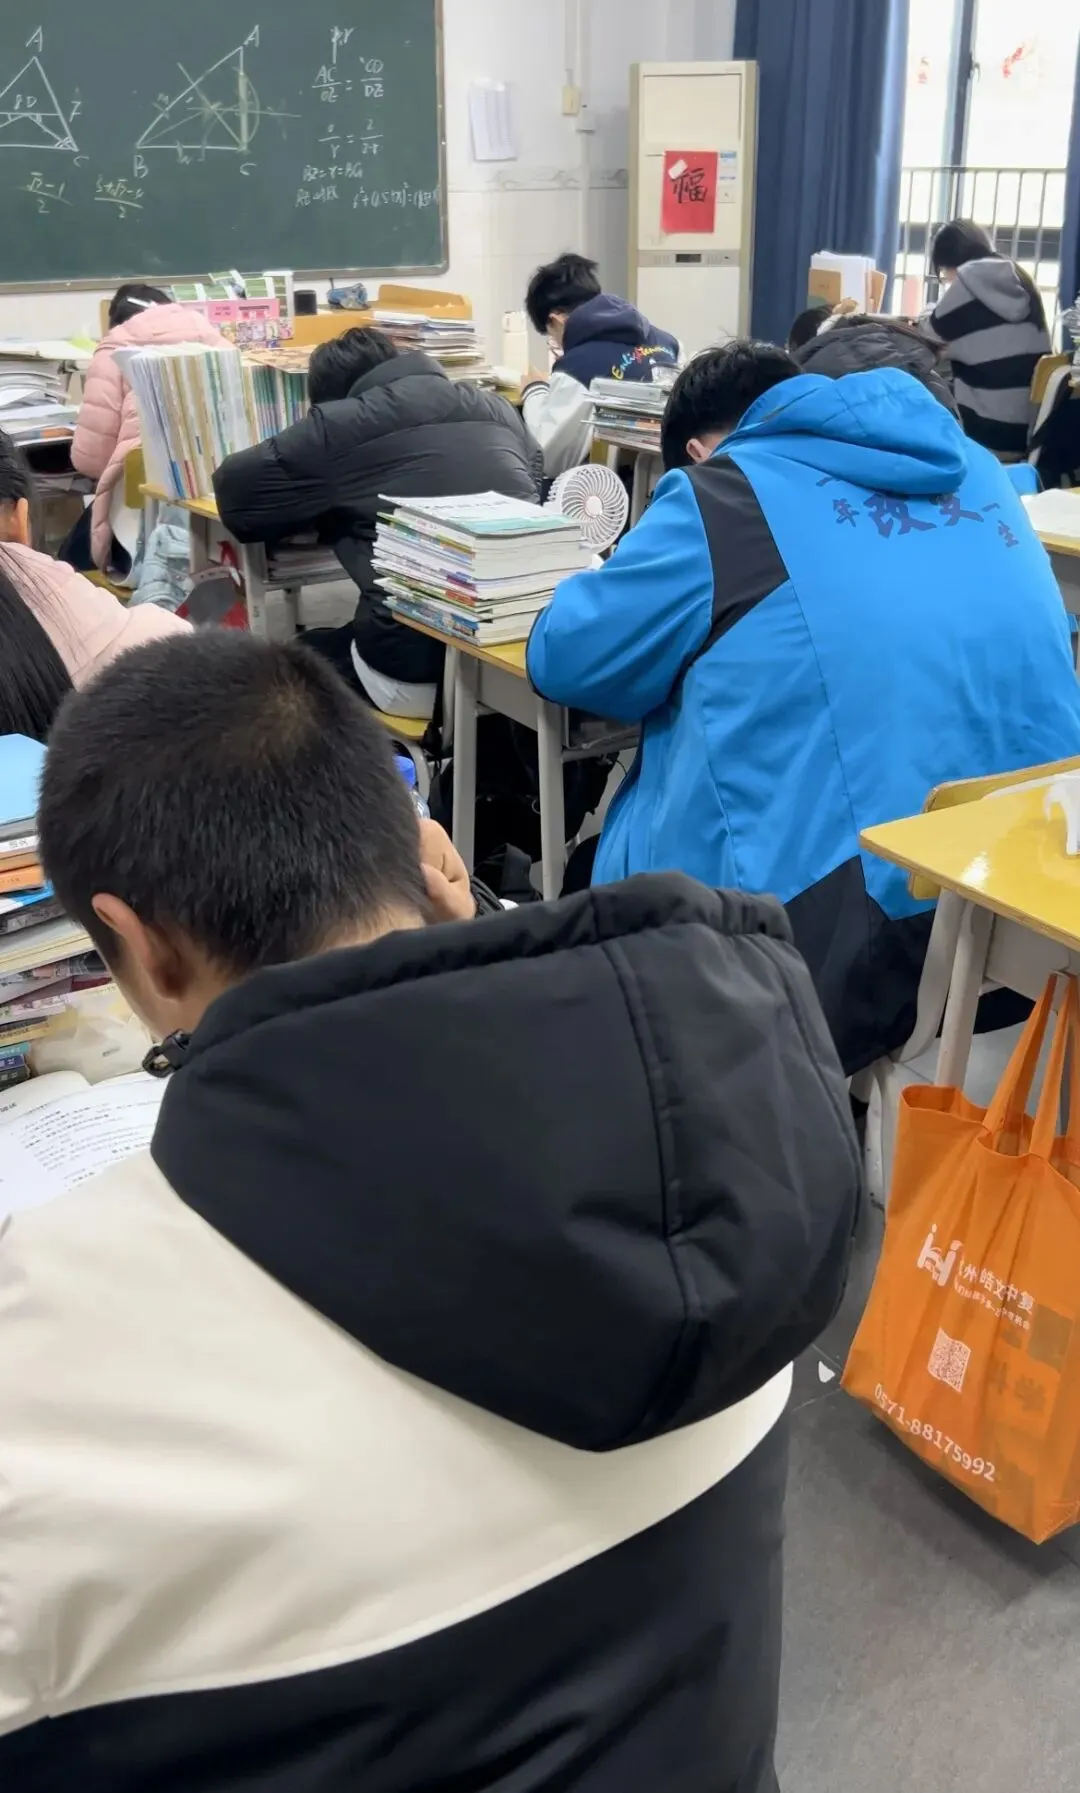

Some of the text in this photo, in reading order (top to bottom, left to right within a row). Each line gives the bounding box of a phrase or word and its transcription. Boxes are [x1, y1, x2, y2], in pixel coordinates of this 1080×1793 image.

[25, 25, 43, 52] A
[243, 24, 260, 48] A
[133, 154, 149, 178] B
[239, 161, 257, 176] C
[671, 168, 708, 204] 福
[36, 199, 50, 214] 2
[873, 1382, 996, 1482] 0571-88175992
